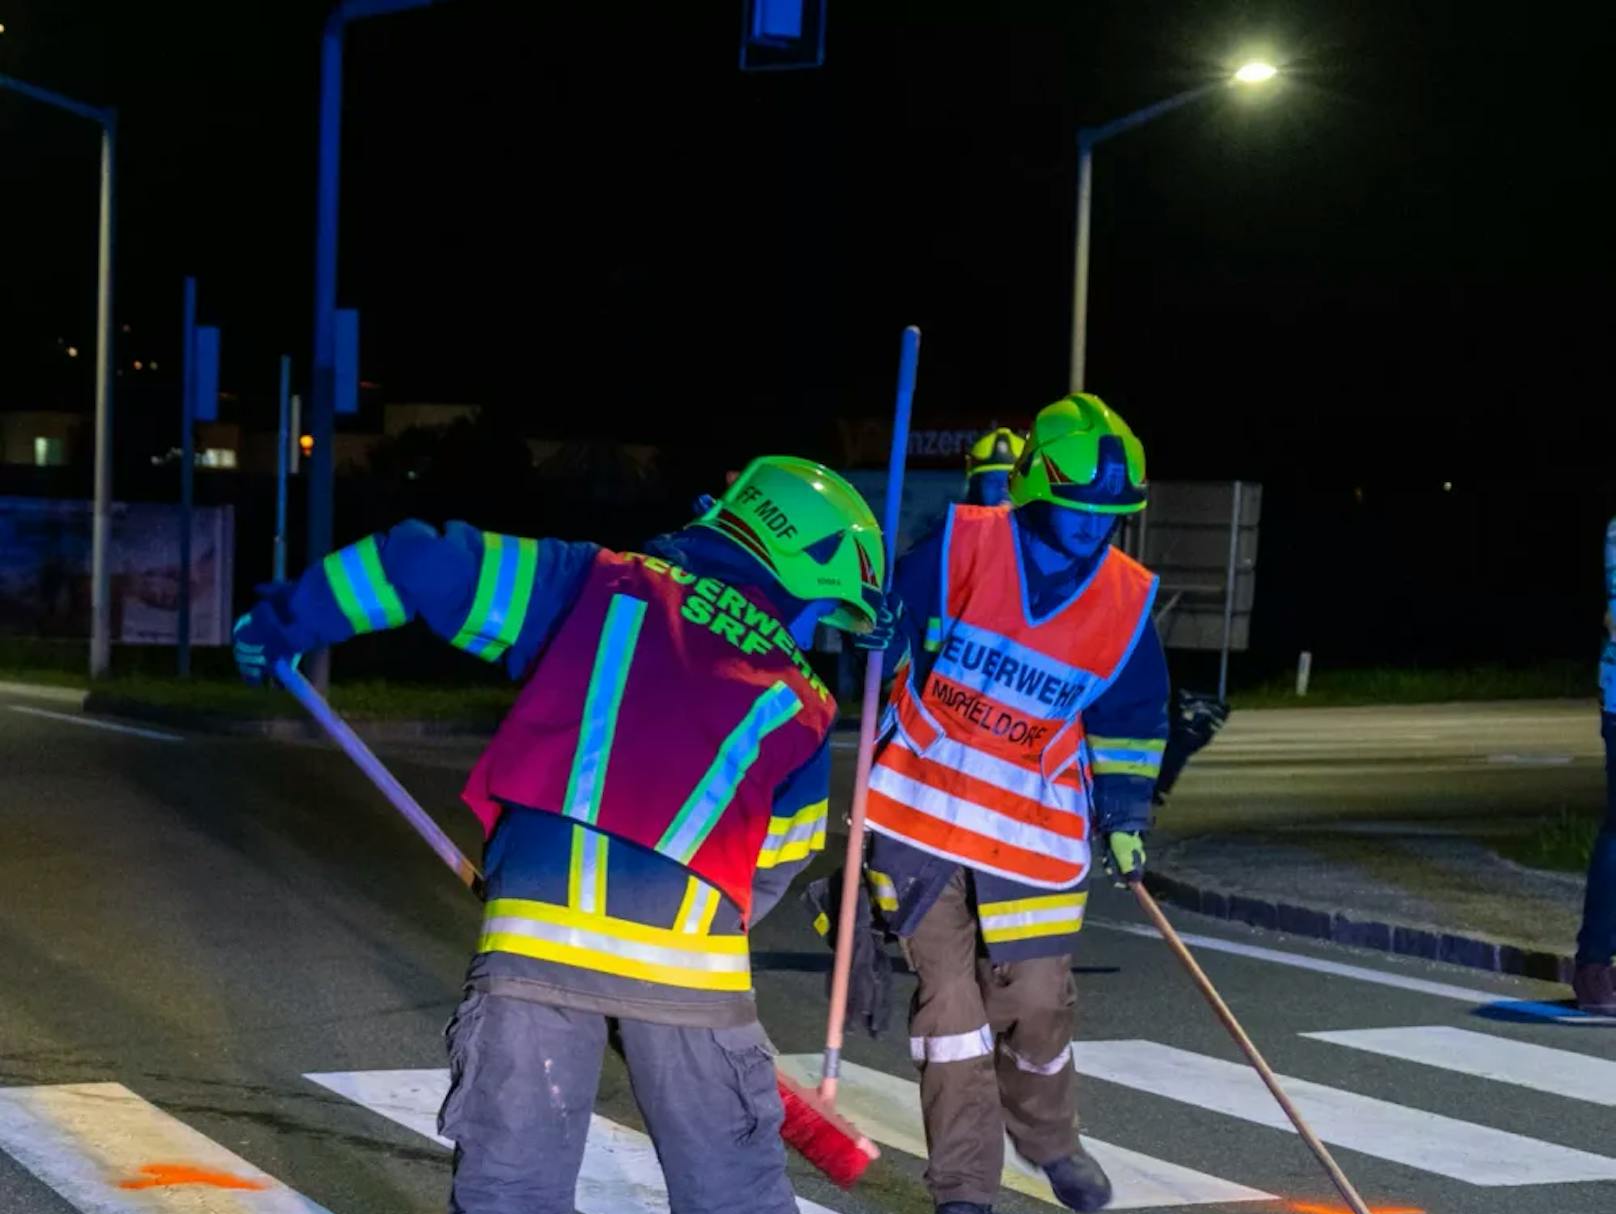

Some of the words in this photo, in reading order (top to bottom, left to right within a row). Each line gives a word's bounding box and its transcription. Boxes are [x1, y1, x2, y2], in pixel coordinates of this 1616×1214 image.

[754, 499, 798, 540] MDF
[681, 596, 773, 655] SRF
[943, 635, 1087, 709] EUERWEHR
